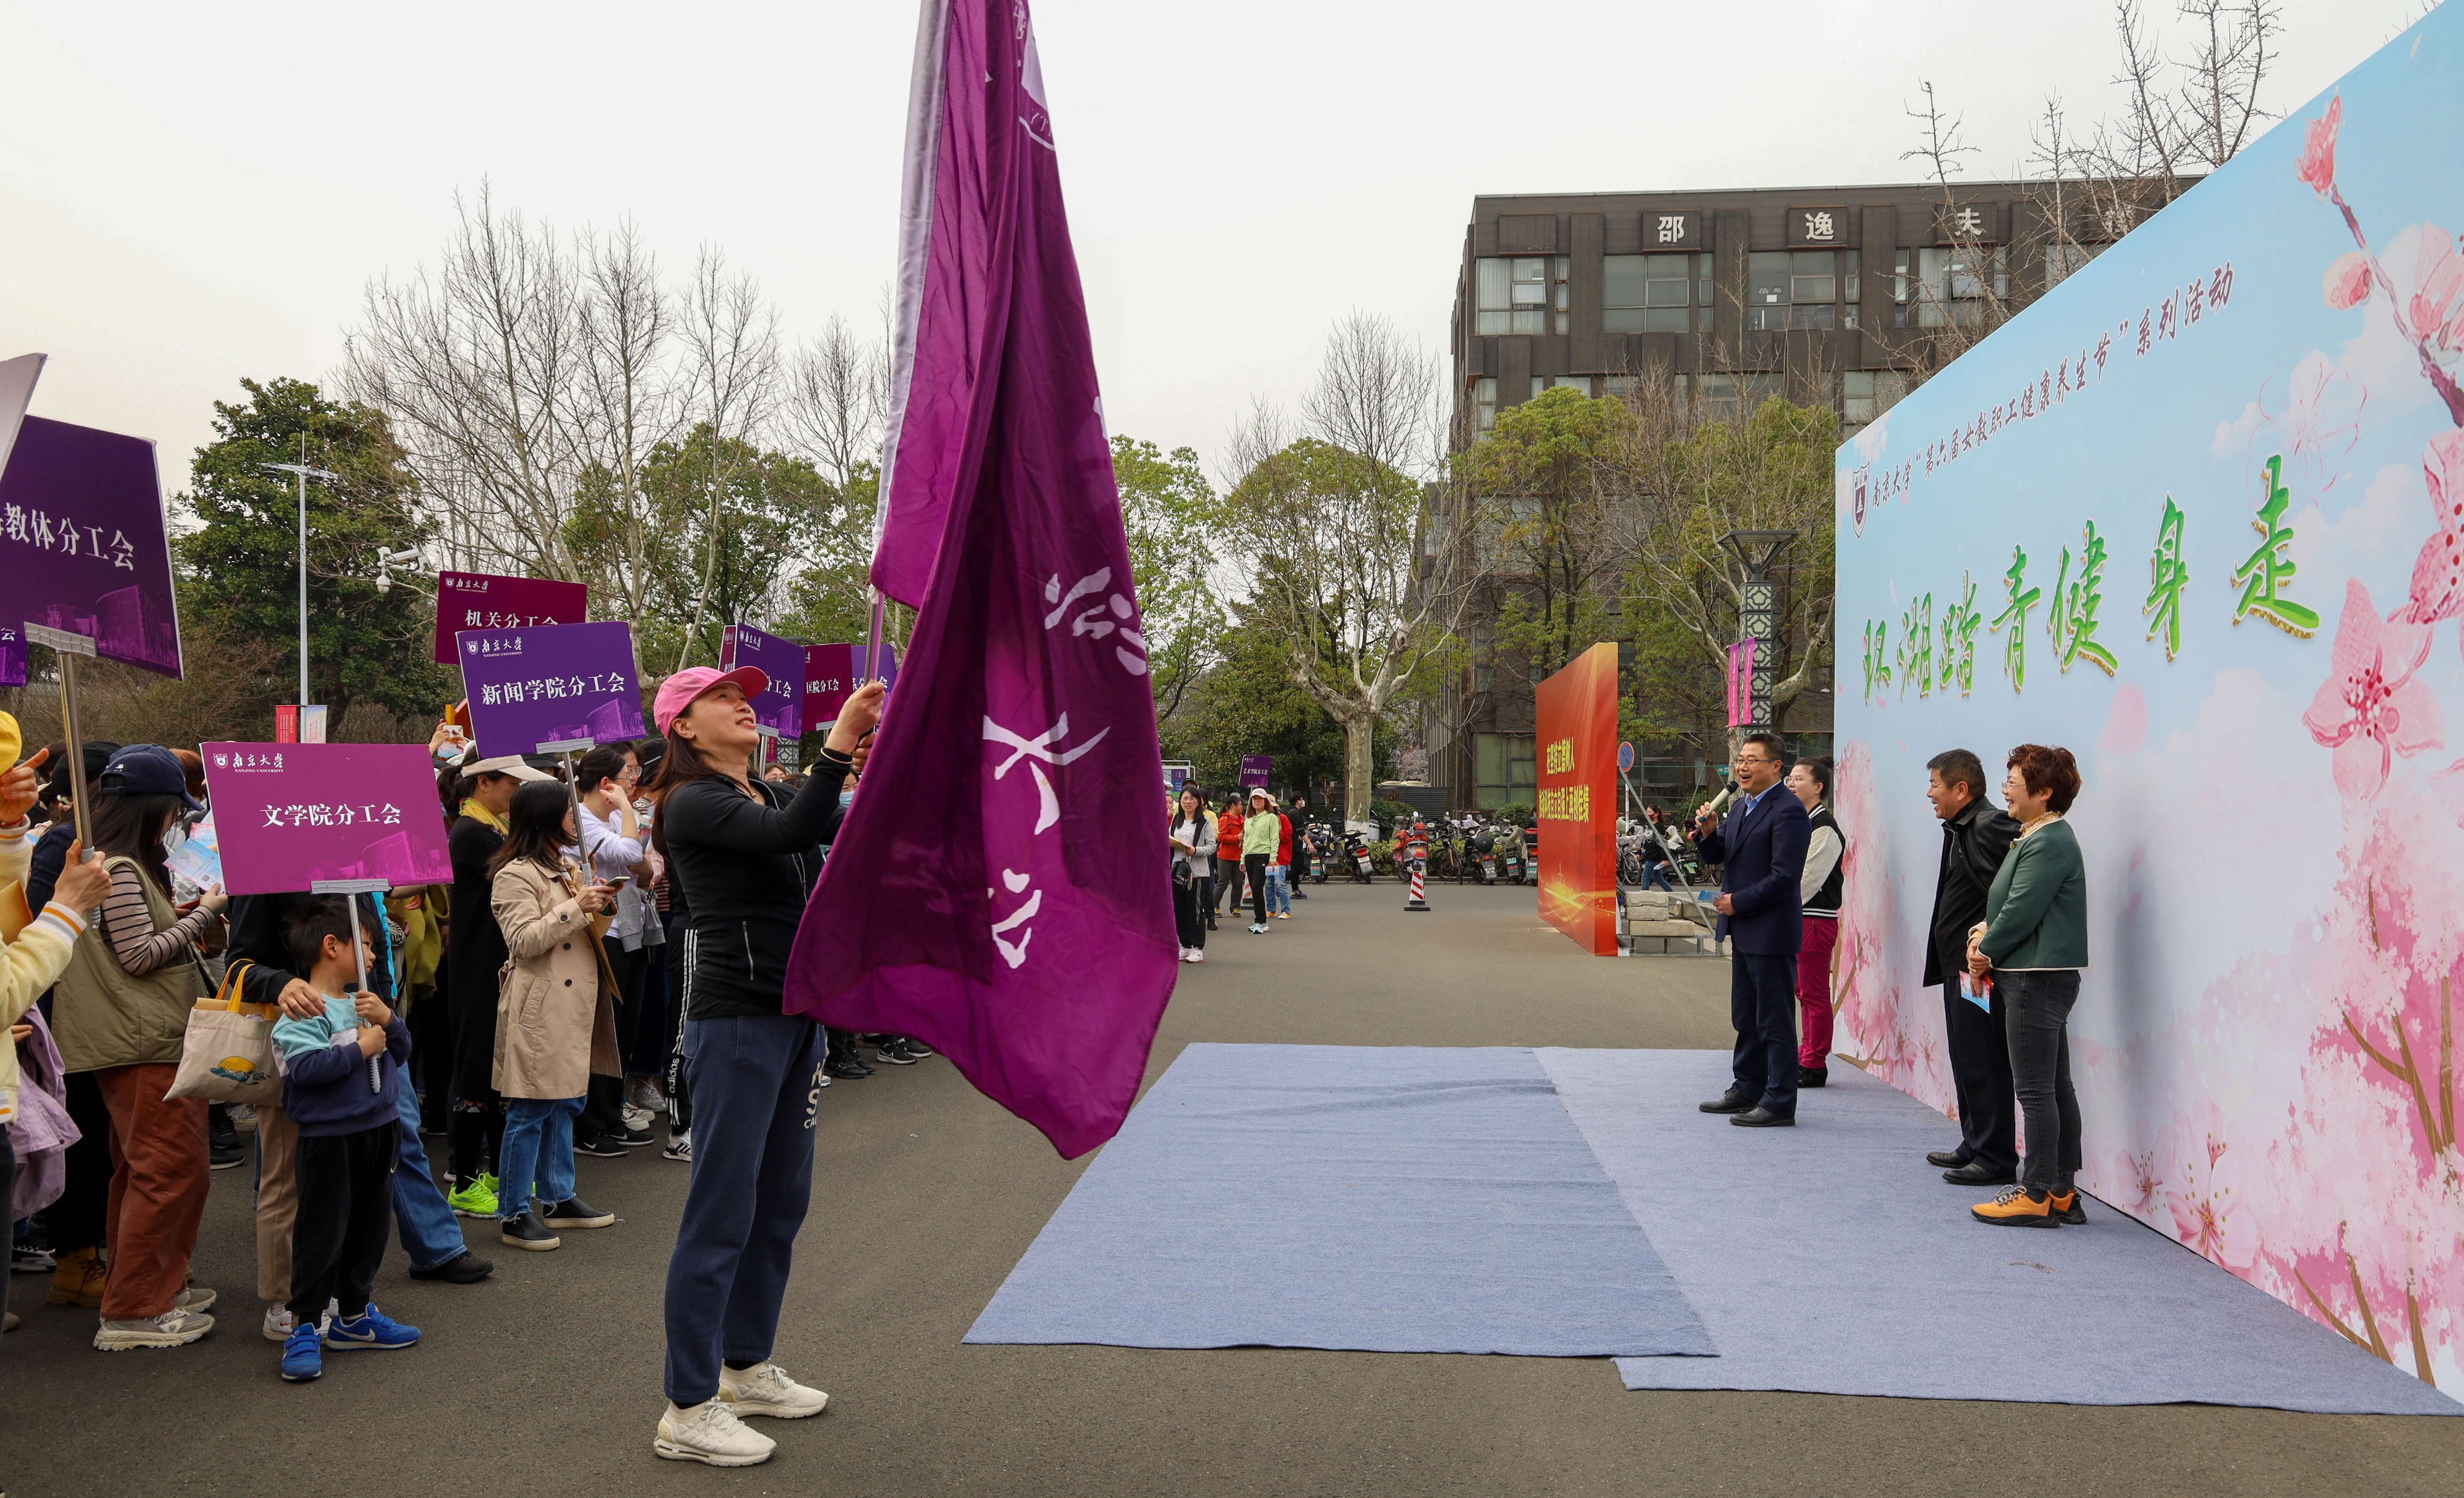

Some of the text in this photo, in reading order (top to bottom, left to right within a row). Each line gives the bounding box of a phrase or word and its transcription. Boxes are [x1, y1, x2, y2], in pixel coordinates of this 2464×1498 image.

[0, 502, 134, 571] 教体分工会
[1863, 454, 2320, 705] 环湖踏青健身走
[480, 672, 625, 705] 新闻学院分工会
[259, 802, 402, 828] 文学院分工会
[668, 1058, 680, 1093] adidas
